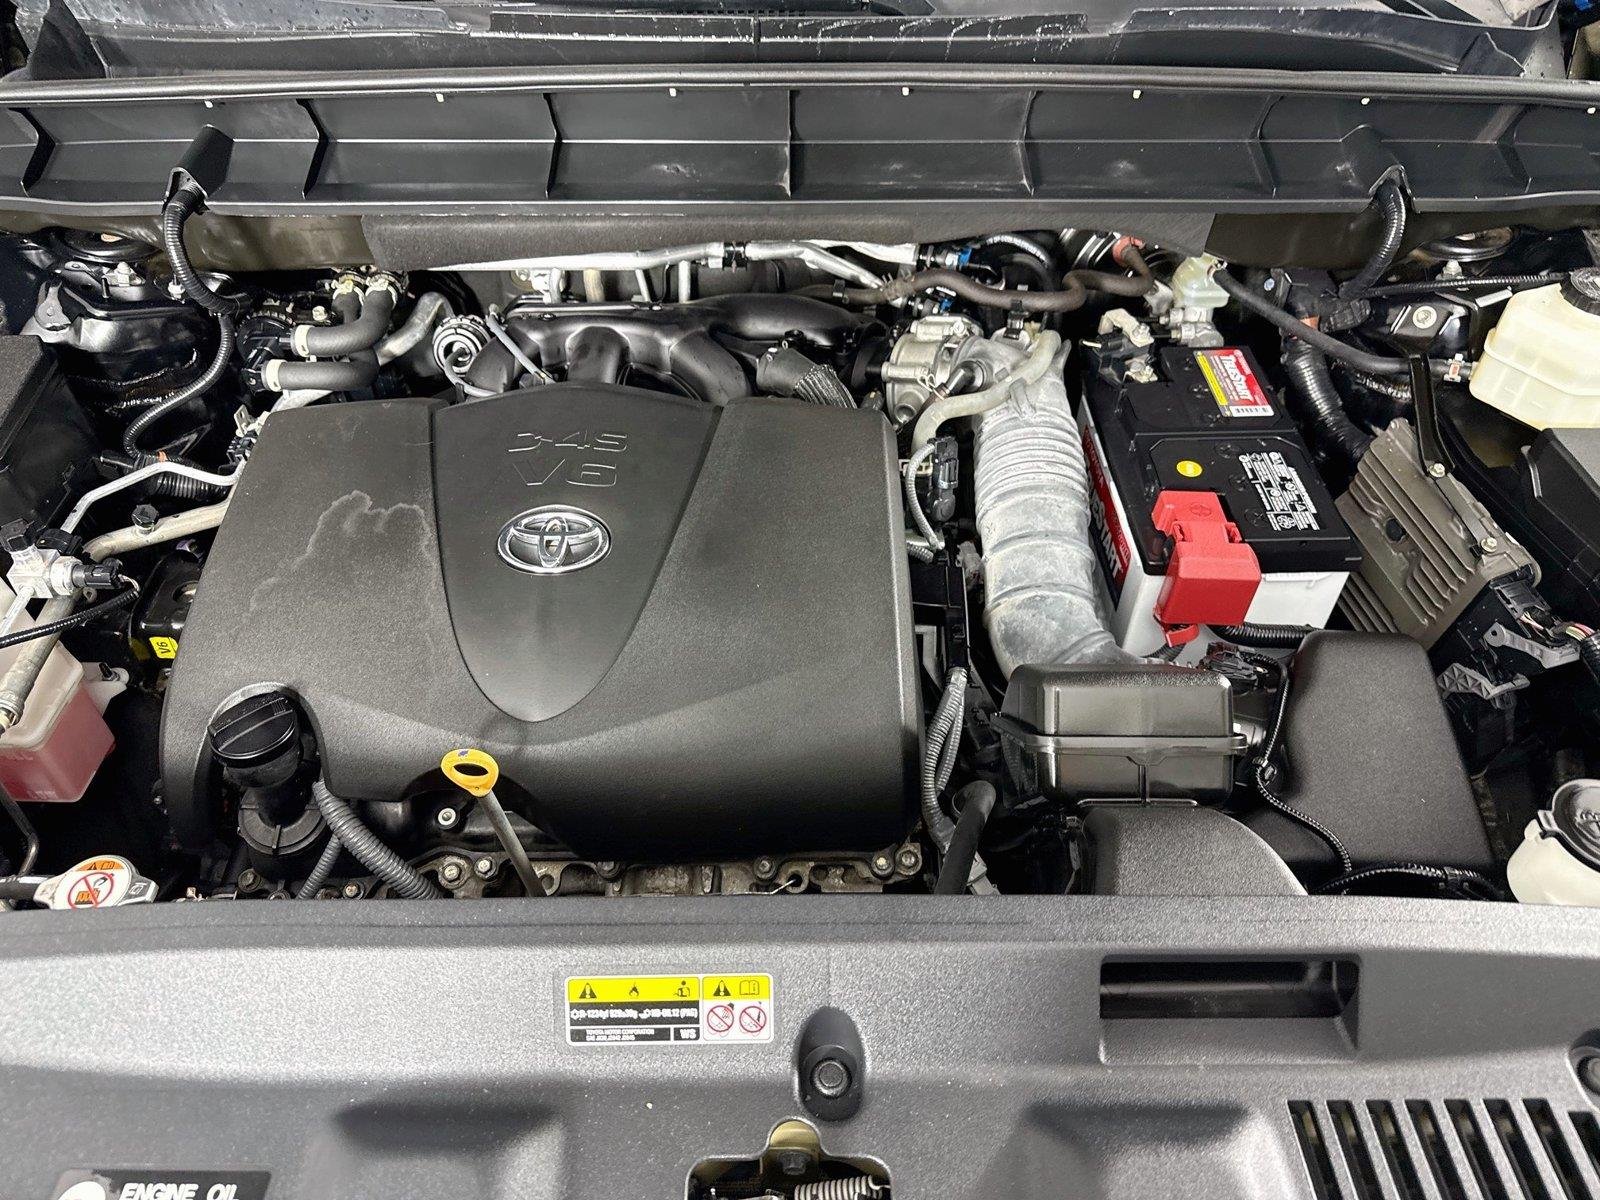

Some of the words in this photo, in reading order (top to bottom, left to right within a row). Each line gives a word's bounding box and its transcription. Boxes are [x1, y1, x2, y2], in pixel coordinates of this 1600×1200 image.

[512, 458, 617, 487] V6
[156, 641, 171, 654] V6
[119, 1182, 199, 1200] ENGINE
[206, 1183, 239, 1200] OIL
